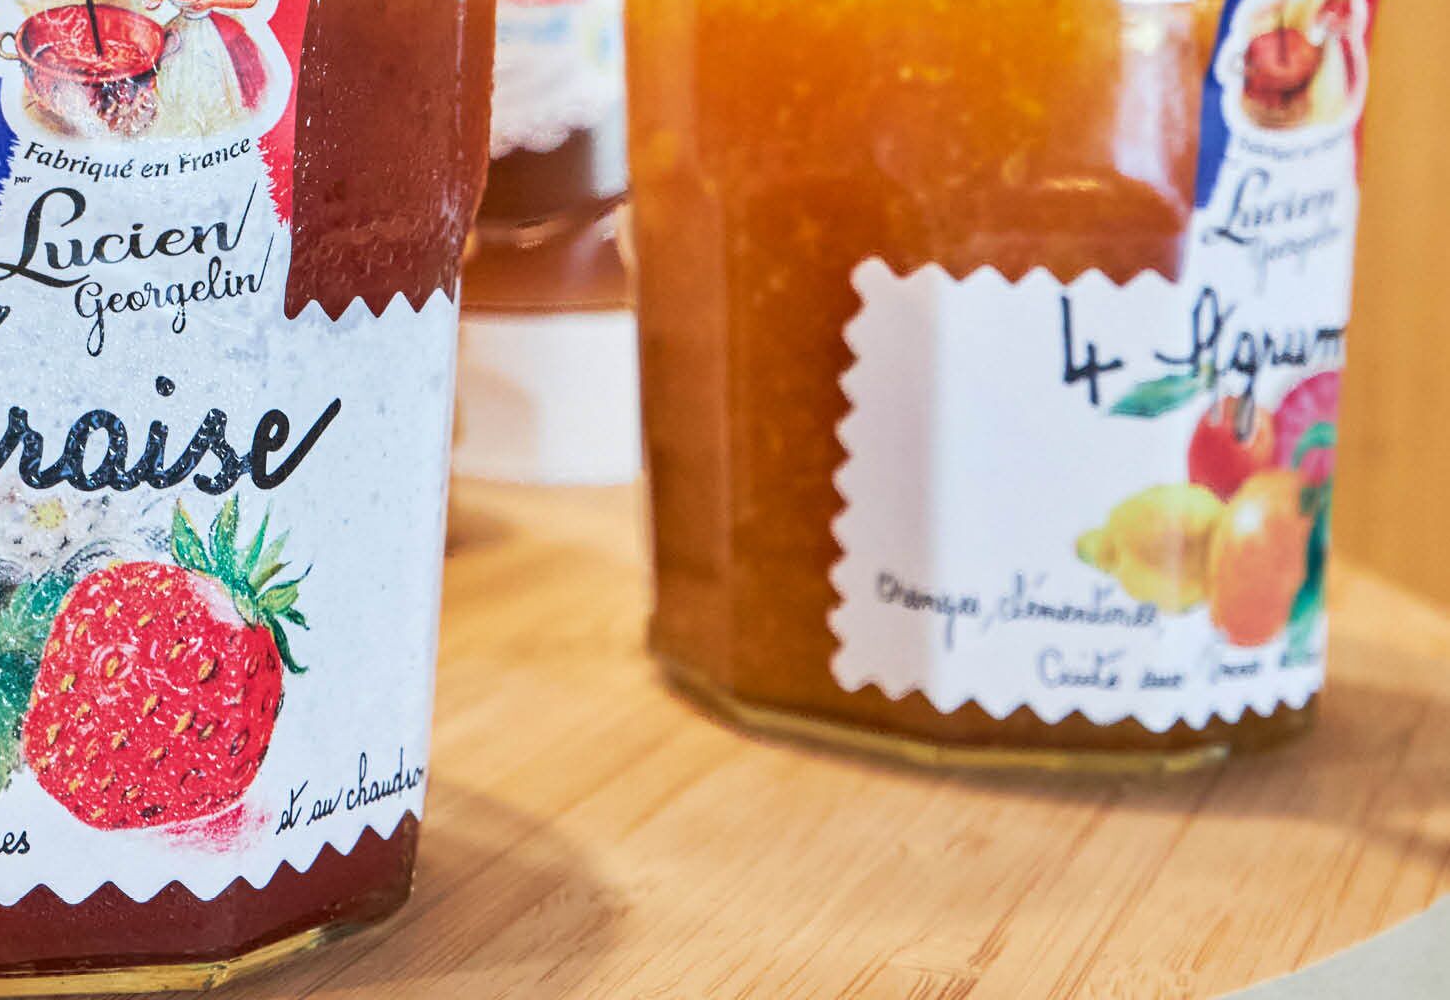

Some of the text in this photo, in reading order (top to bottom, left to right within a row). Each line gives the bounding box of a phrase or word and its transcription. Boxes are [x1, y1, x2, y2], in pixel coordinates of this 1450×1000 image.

[14, 175, 32, 186] par
[24, 137, 252, 182] Fabriqué en France
[74, 232, 275, 357] Georgelin
[1060, 295, 1124, 405] 4
[276, 780, 309, 835] et
[306, 787, 343, 826] au
[346, 745, 425, 811] chaudro
